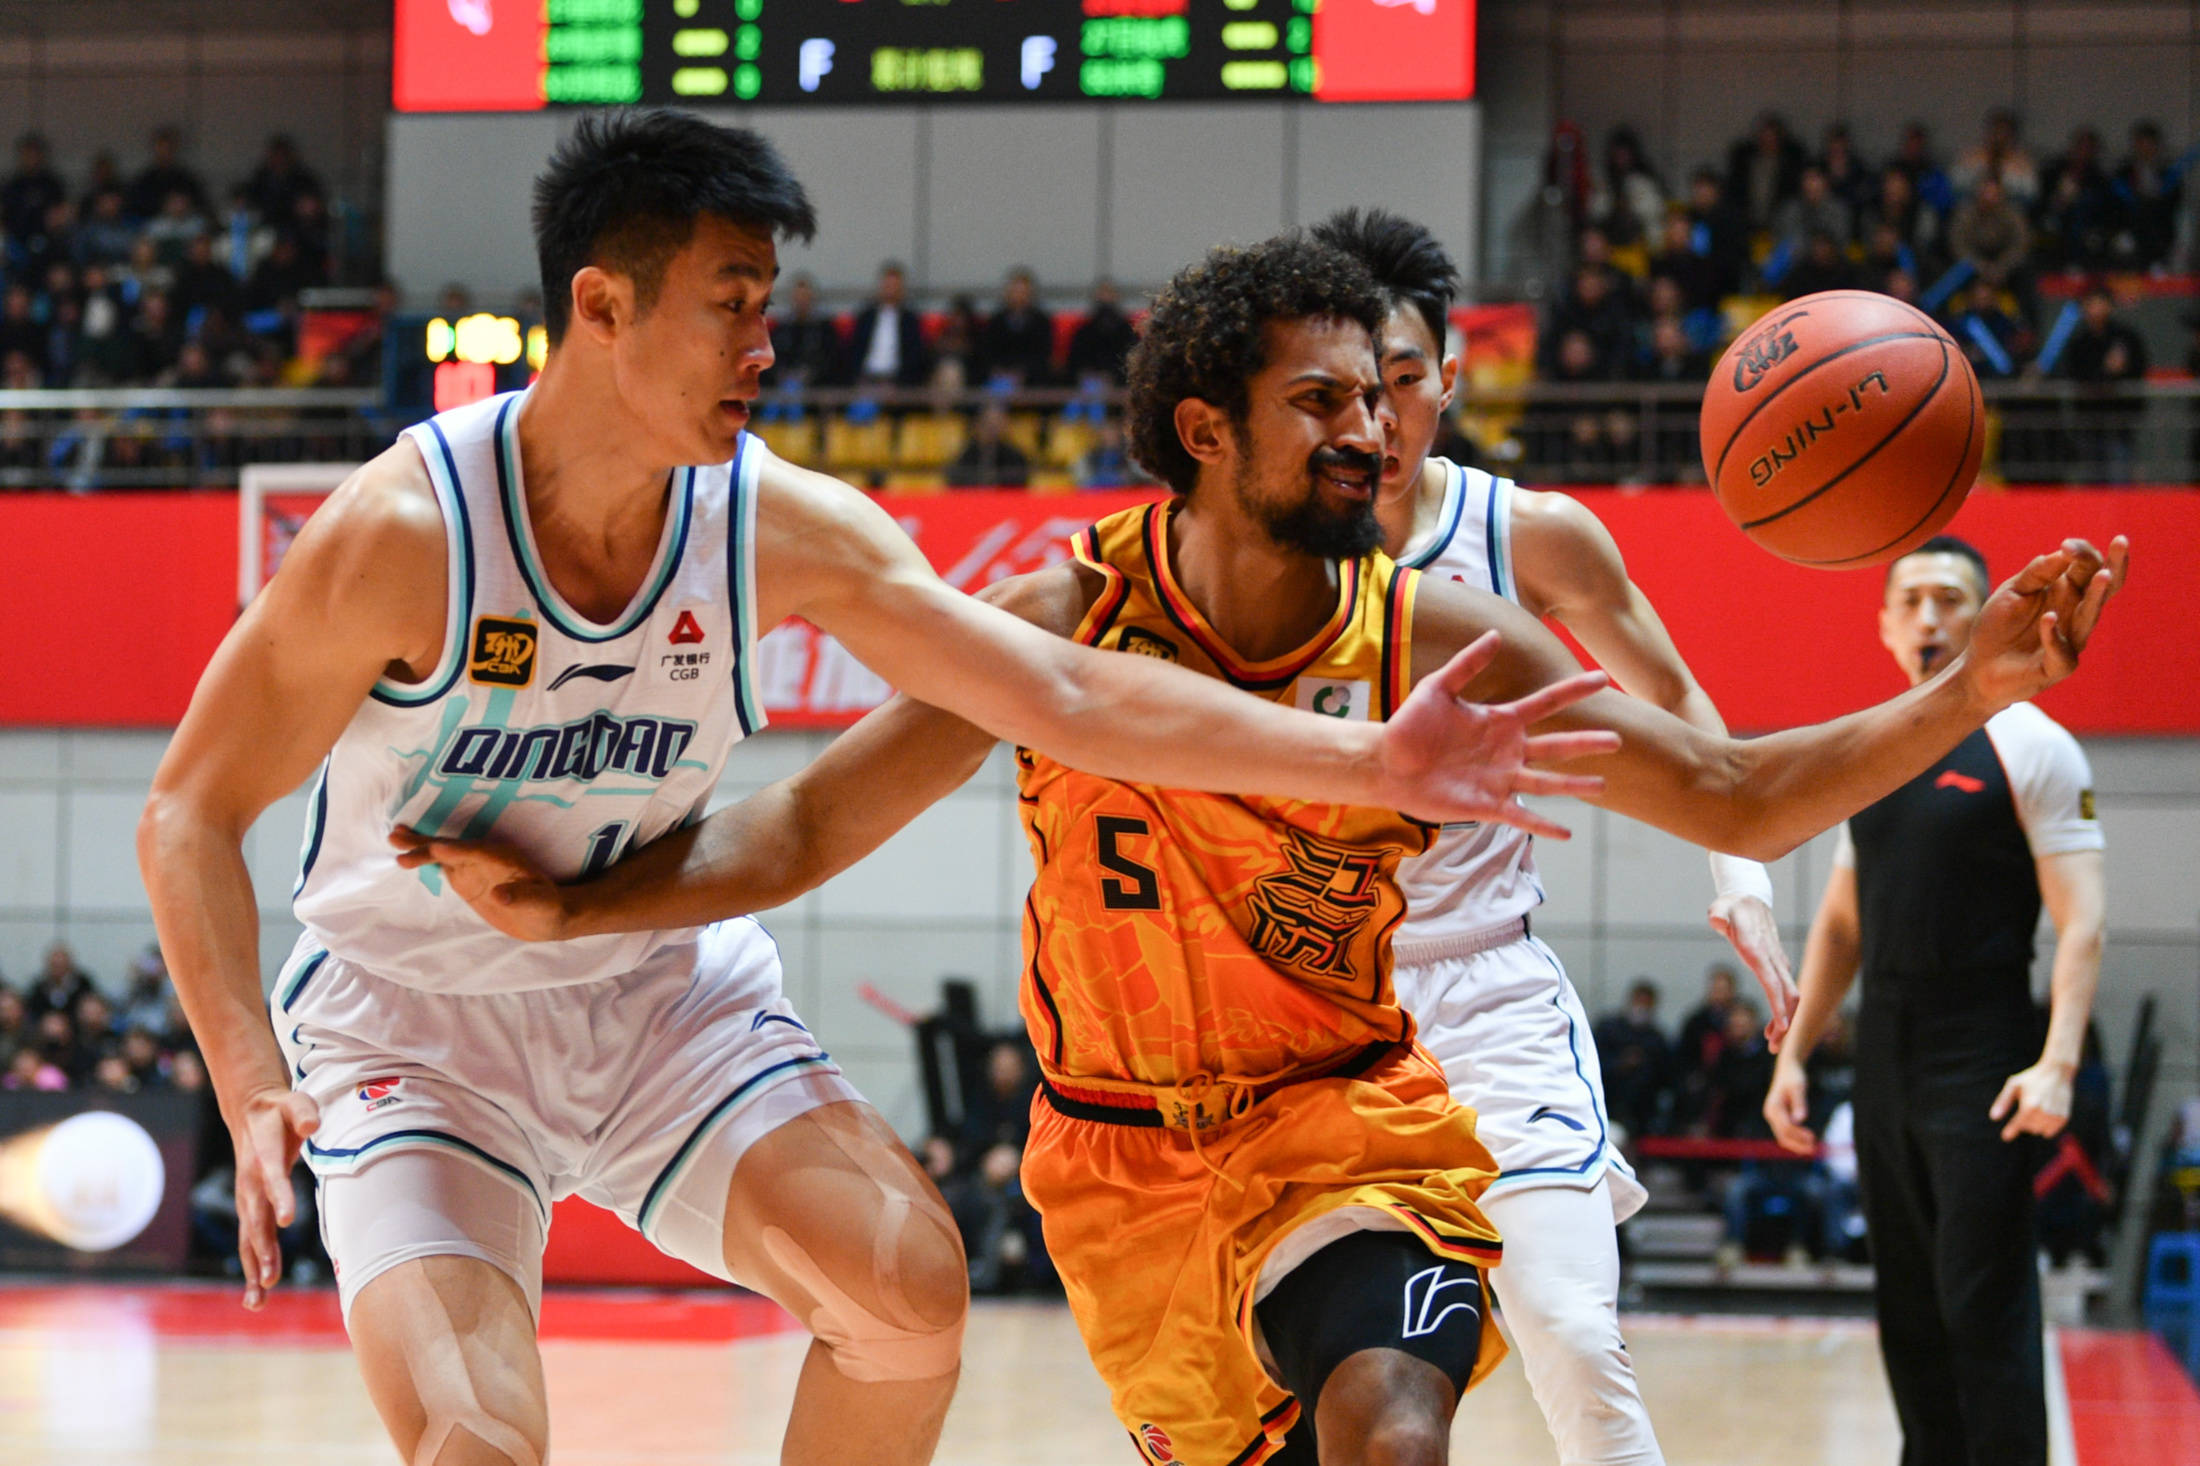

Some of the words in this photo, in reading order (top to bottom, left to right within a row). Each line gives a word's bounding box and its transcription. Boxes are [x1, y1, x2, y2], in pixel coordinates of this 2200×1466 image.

[1750, 370, 1888, 487] LI-NING
[670, 667, 699, 681] CGB
[437, 711, 697, 782] QINGDAO
[1095, 814, 1162, 912] 5
